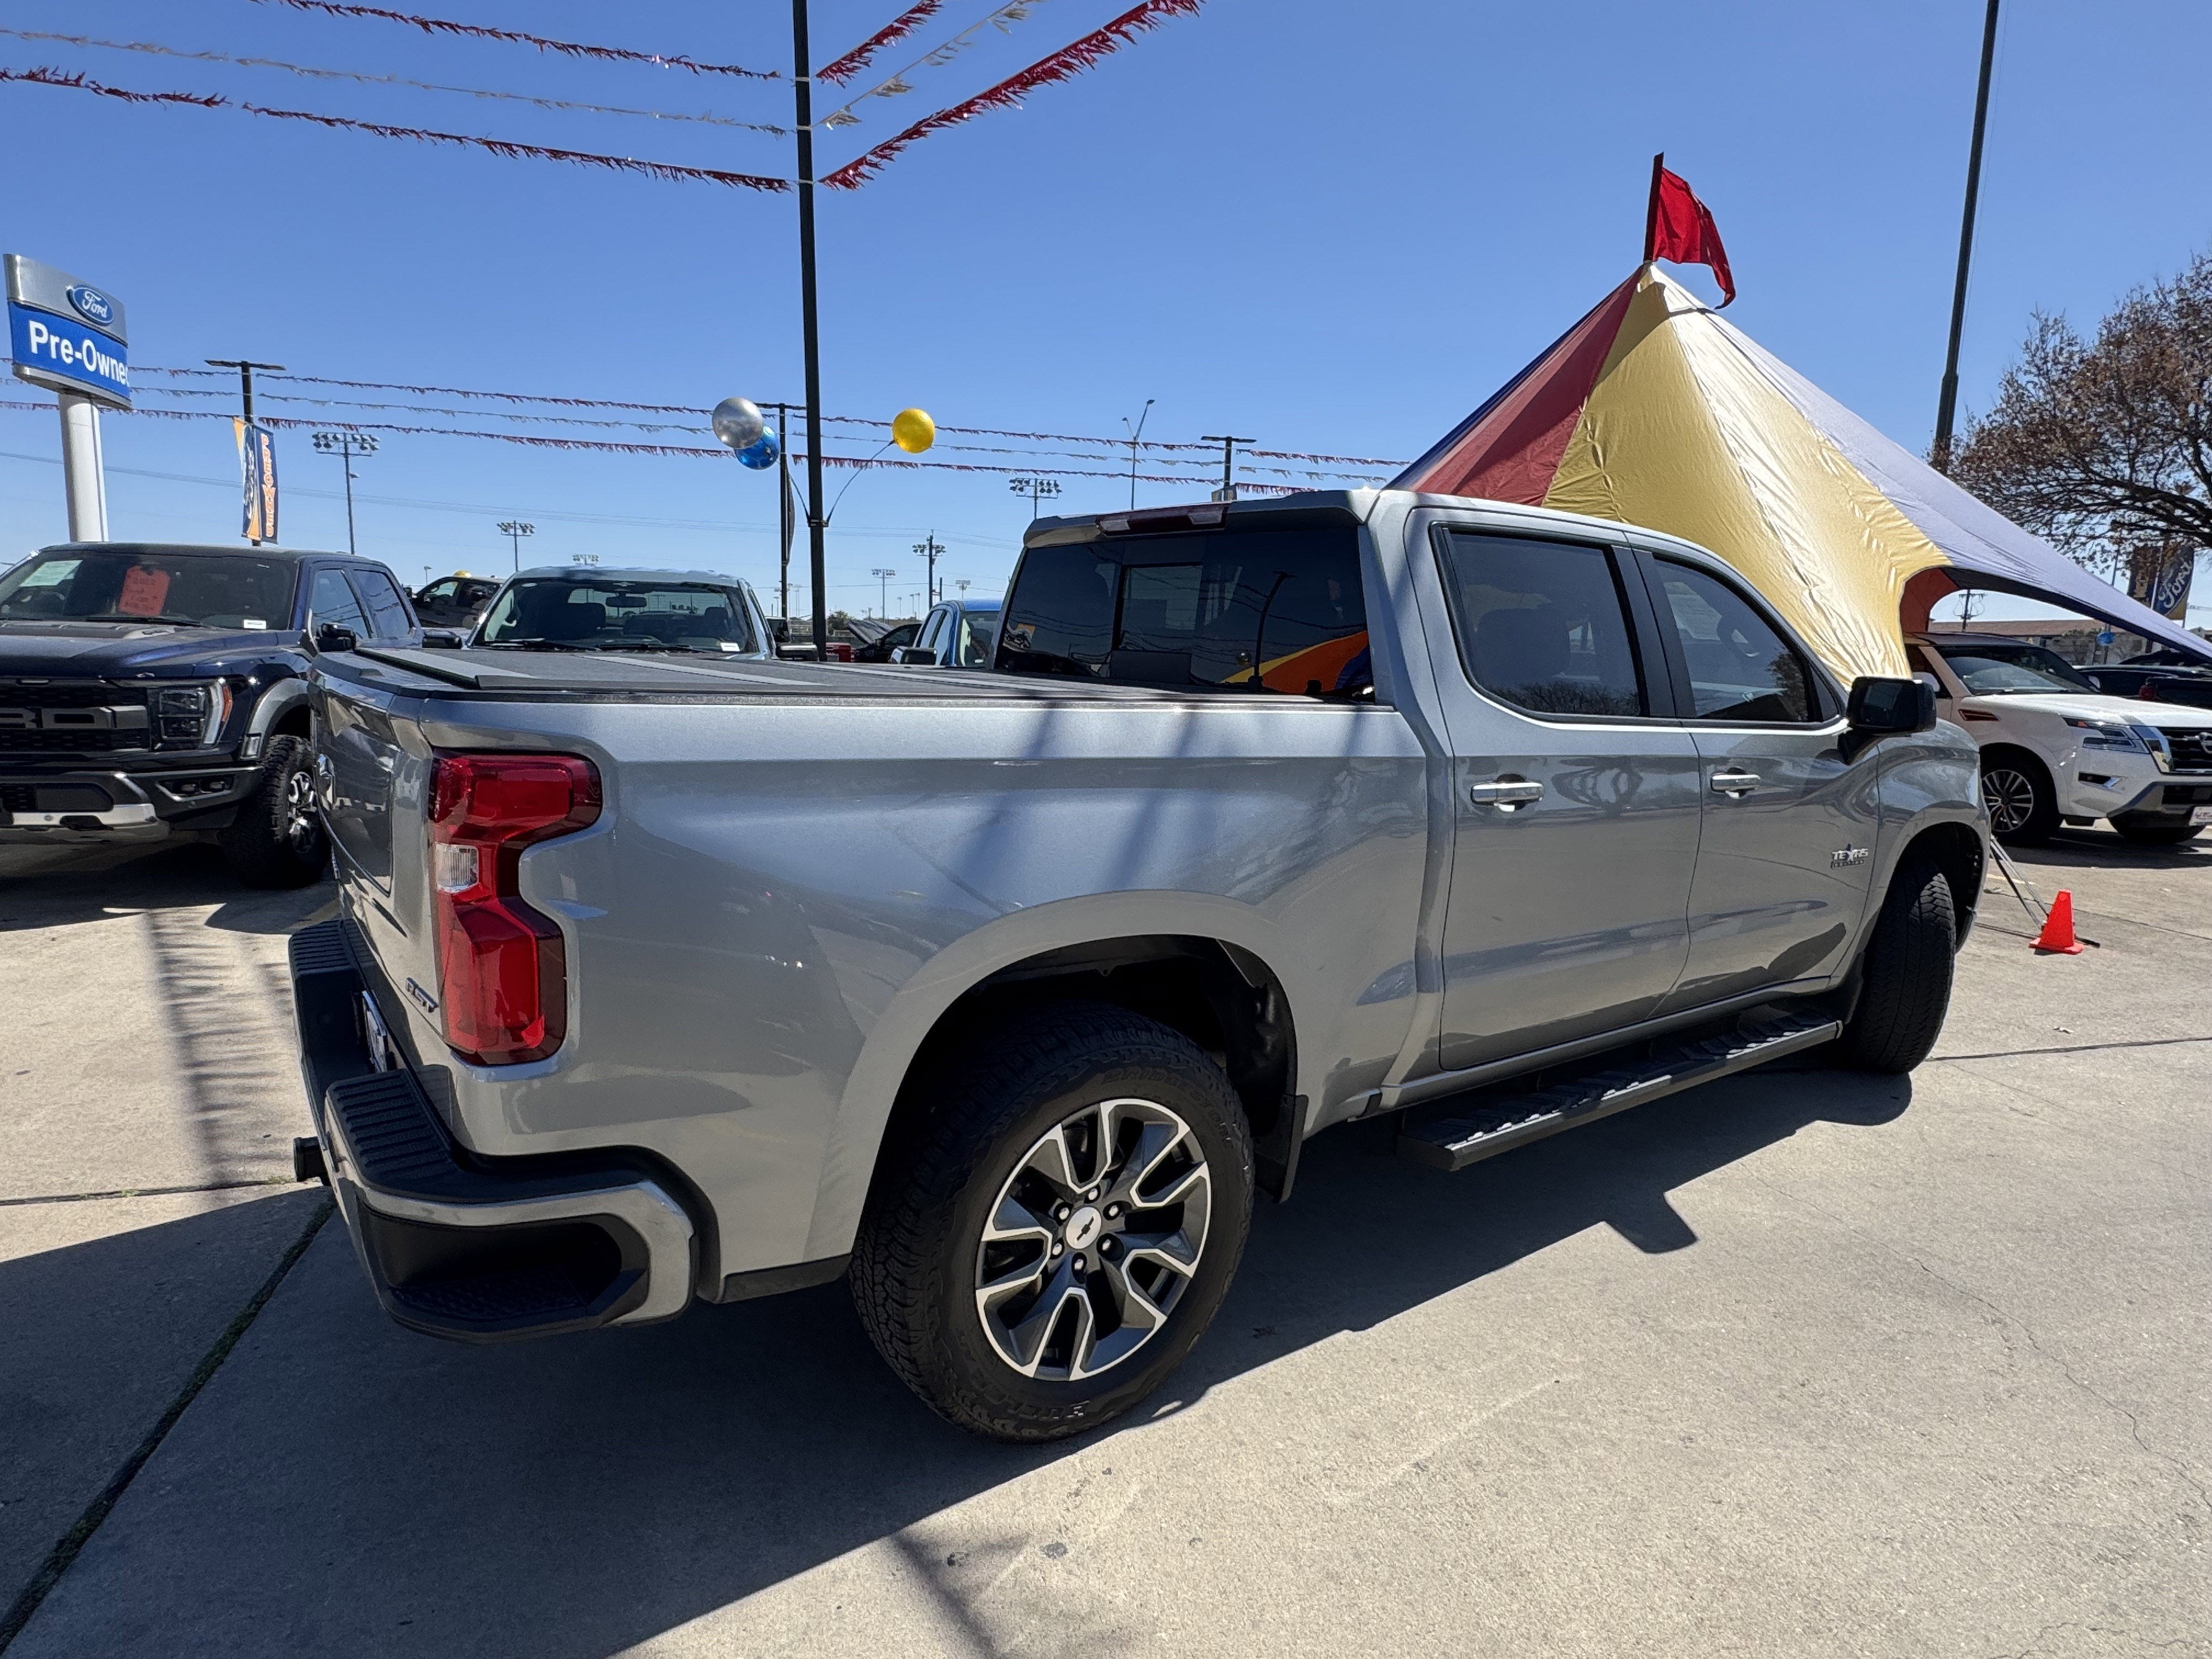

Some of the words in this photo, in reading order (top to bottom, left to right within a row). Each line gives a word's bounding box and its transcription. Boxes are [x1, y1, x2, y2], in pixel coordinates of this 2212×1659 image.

[82, 291, 108, 318] Ford
[2158, 560, 2192, 608] Ford
[1832, 848, 1868, 861] TEXAS
[405, 977, 438, 1013] RST
